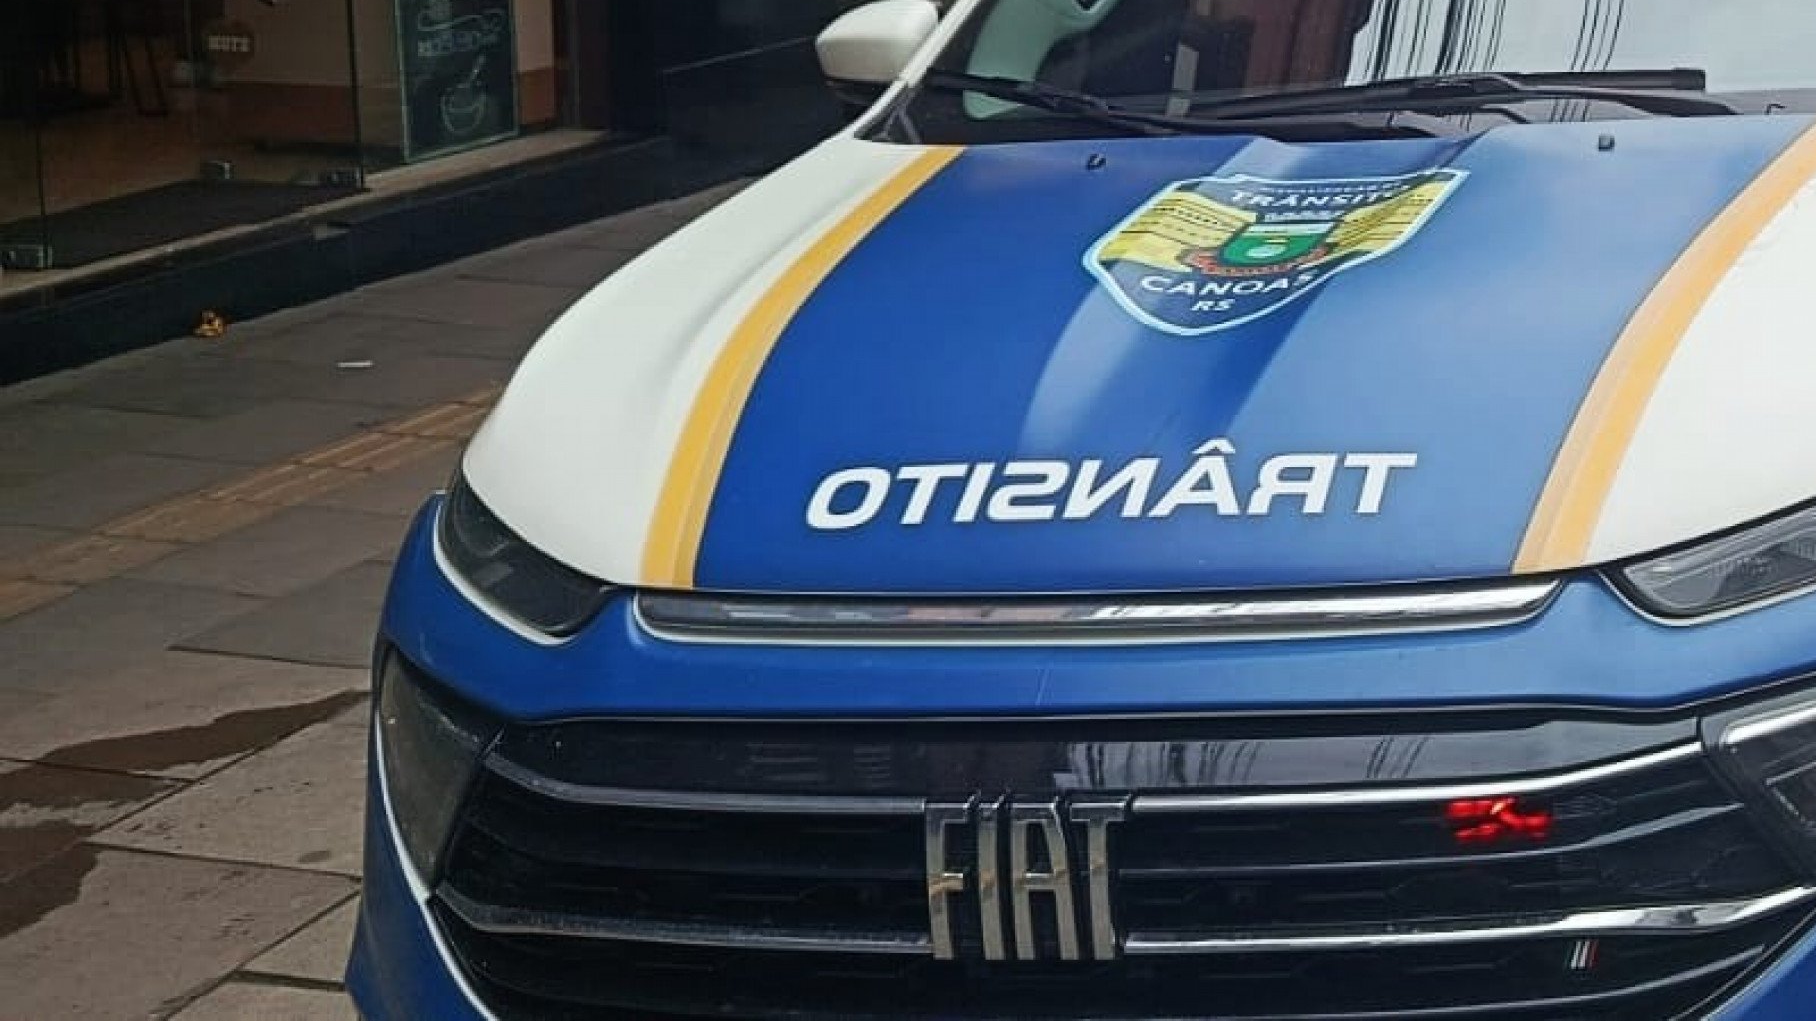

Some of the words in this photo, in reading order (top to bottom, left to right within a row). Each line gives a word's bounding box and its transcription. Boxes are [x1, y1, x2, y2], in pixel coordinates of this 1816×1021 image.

[1140, 271, 1317, 295] CANOAS
[1190, 298, 1236, 312] RS
[923, 788, 1132, 962] FIAT
